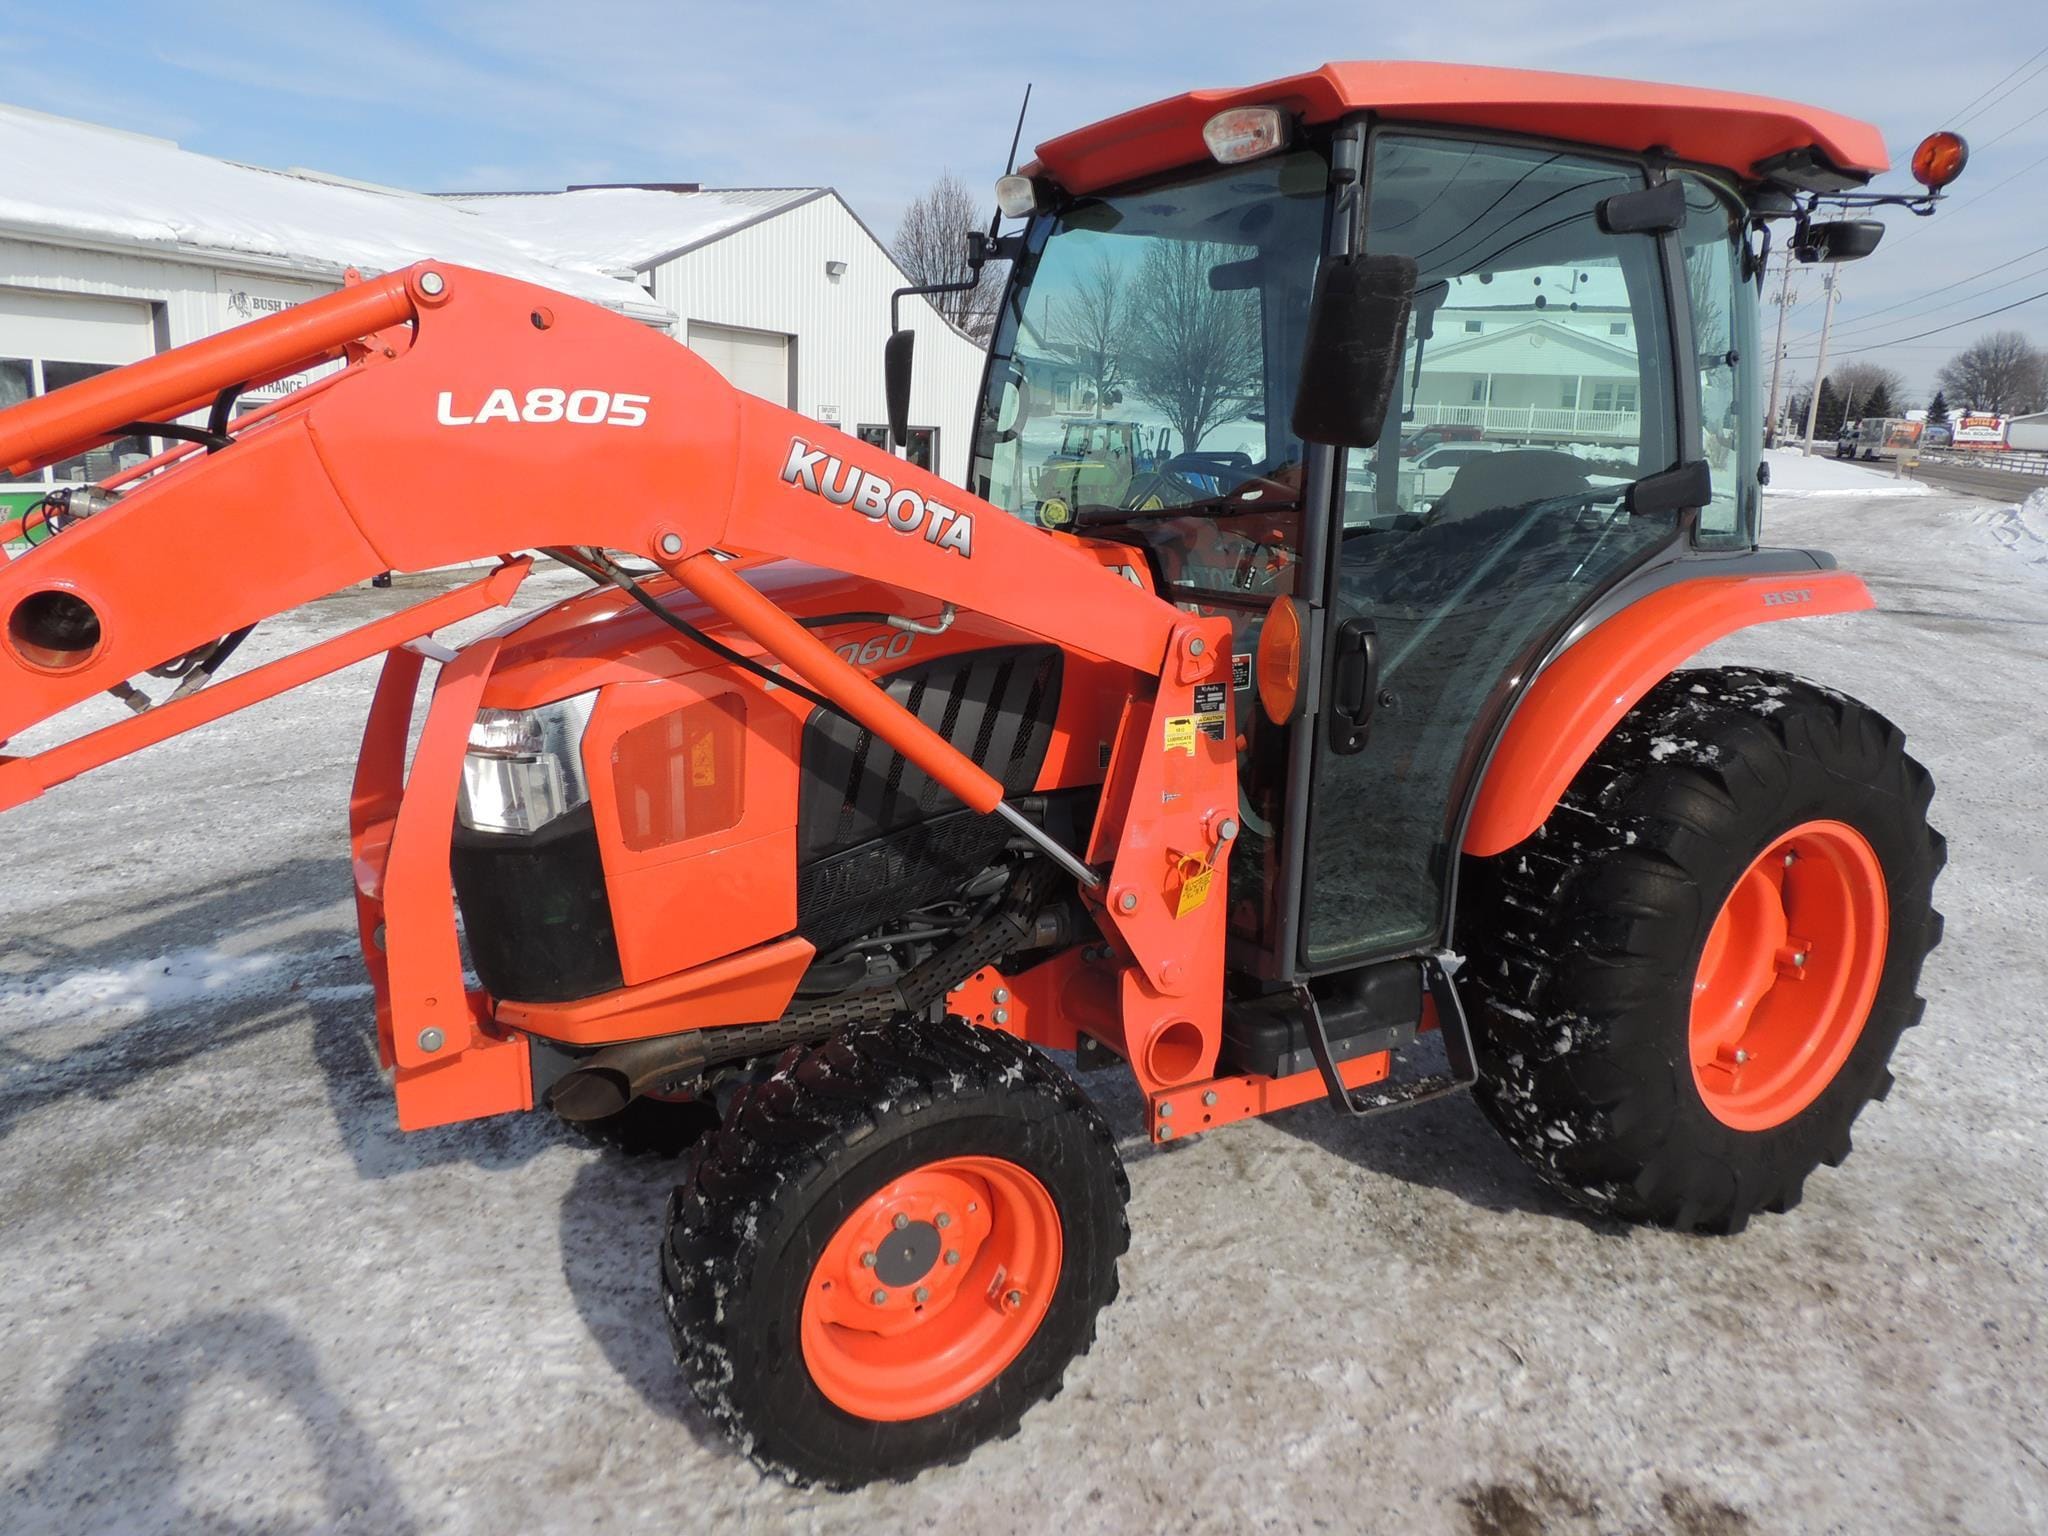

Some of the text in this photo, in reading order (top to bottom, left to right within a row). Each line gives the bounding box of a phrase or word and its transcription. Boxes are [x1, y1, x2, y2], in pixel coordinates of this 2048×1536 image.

[252, 298, 281, 311] BUSH
[437, 388, 650, 427] LA805
[783, 440, 972, 559] KUBOTA
